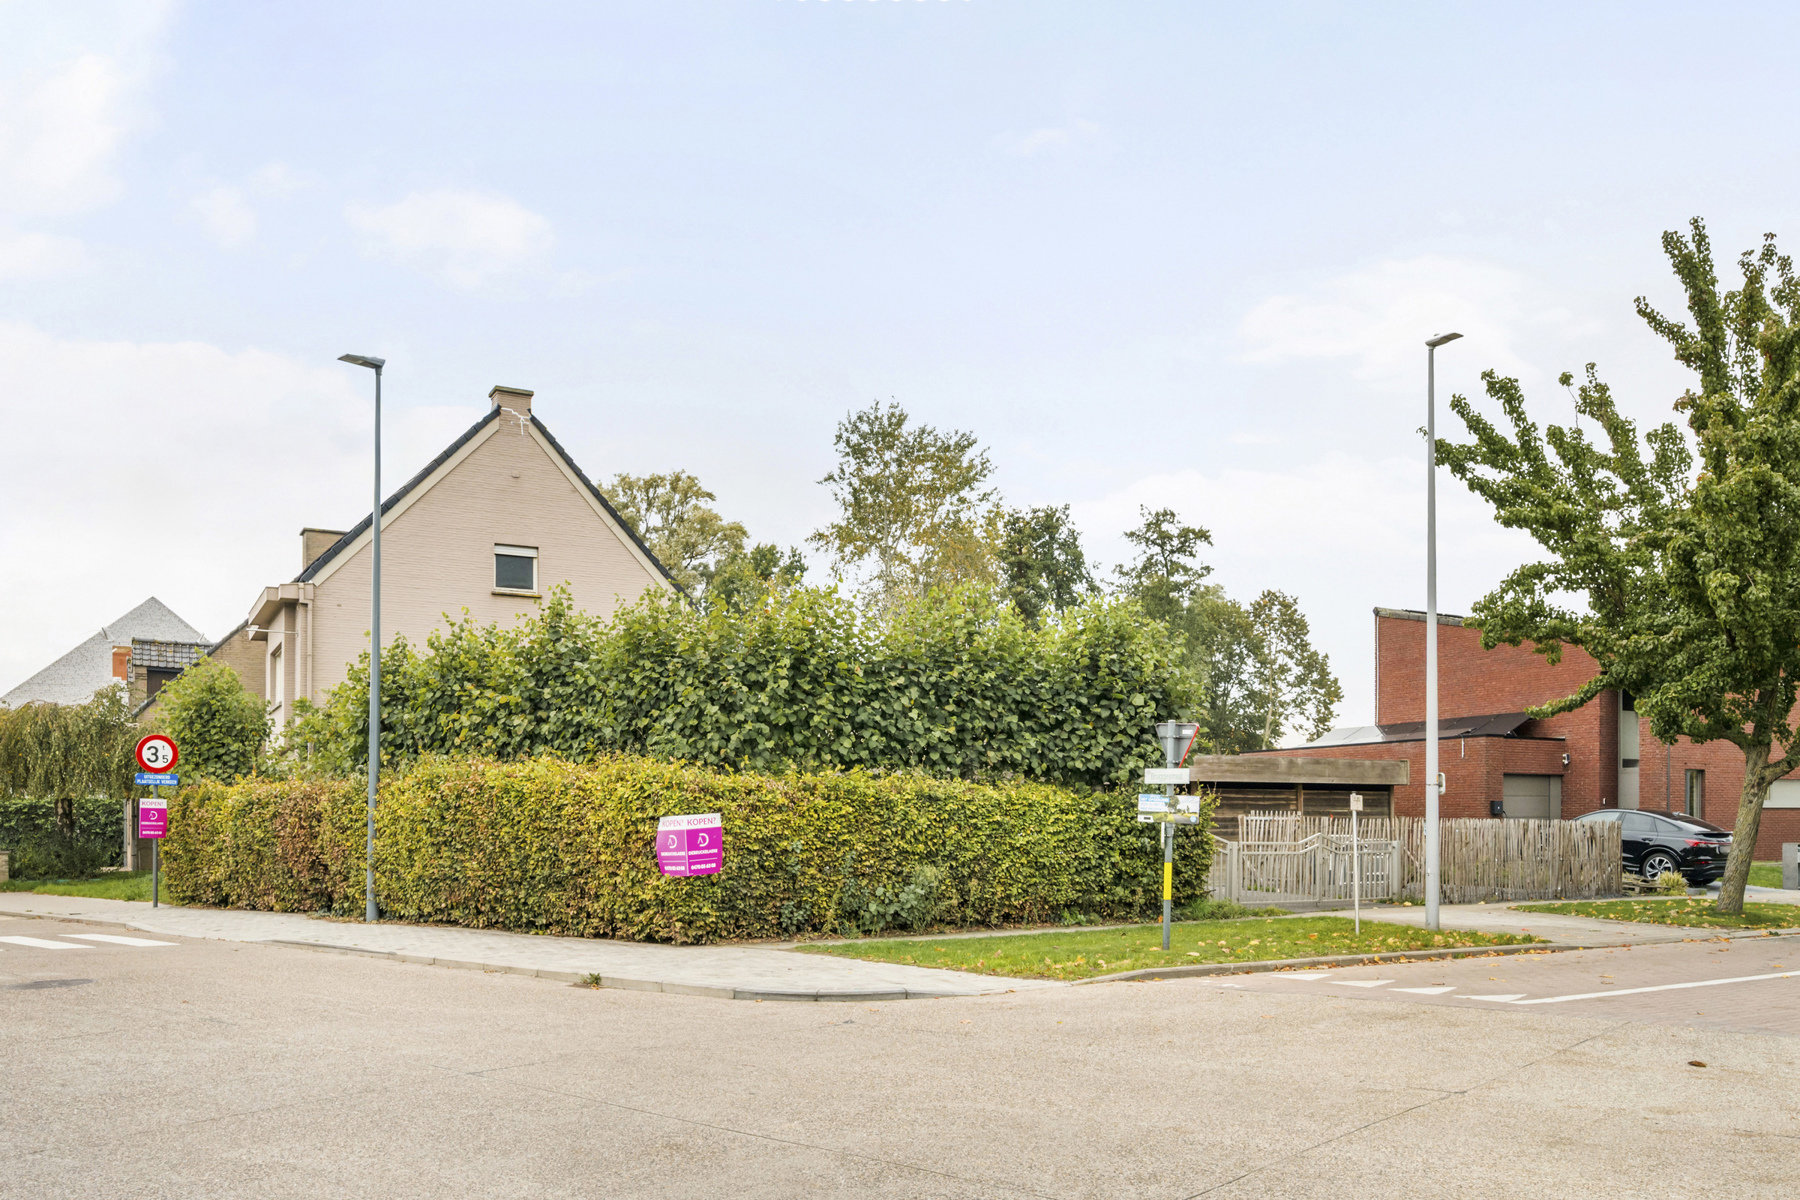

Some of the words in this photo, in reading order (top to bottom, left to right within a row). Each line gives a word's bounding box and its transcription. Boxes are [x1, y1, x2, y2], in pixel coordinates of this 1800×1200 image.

[146, 746, 159, 763] 3
[162, 755, 169, 763] 5
[662, 819, 684, 827] KOPEN?
[687, 817, 716, 826] KOPEN?
